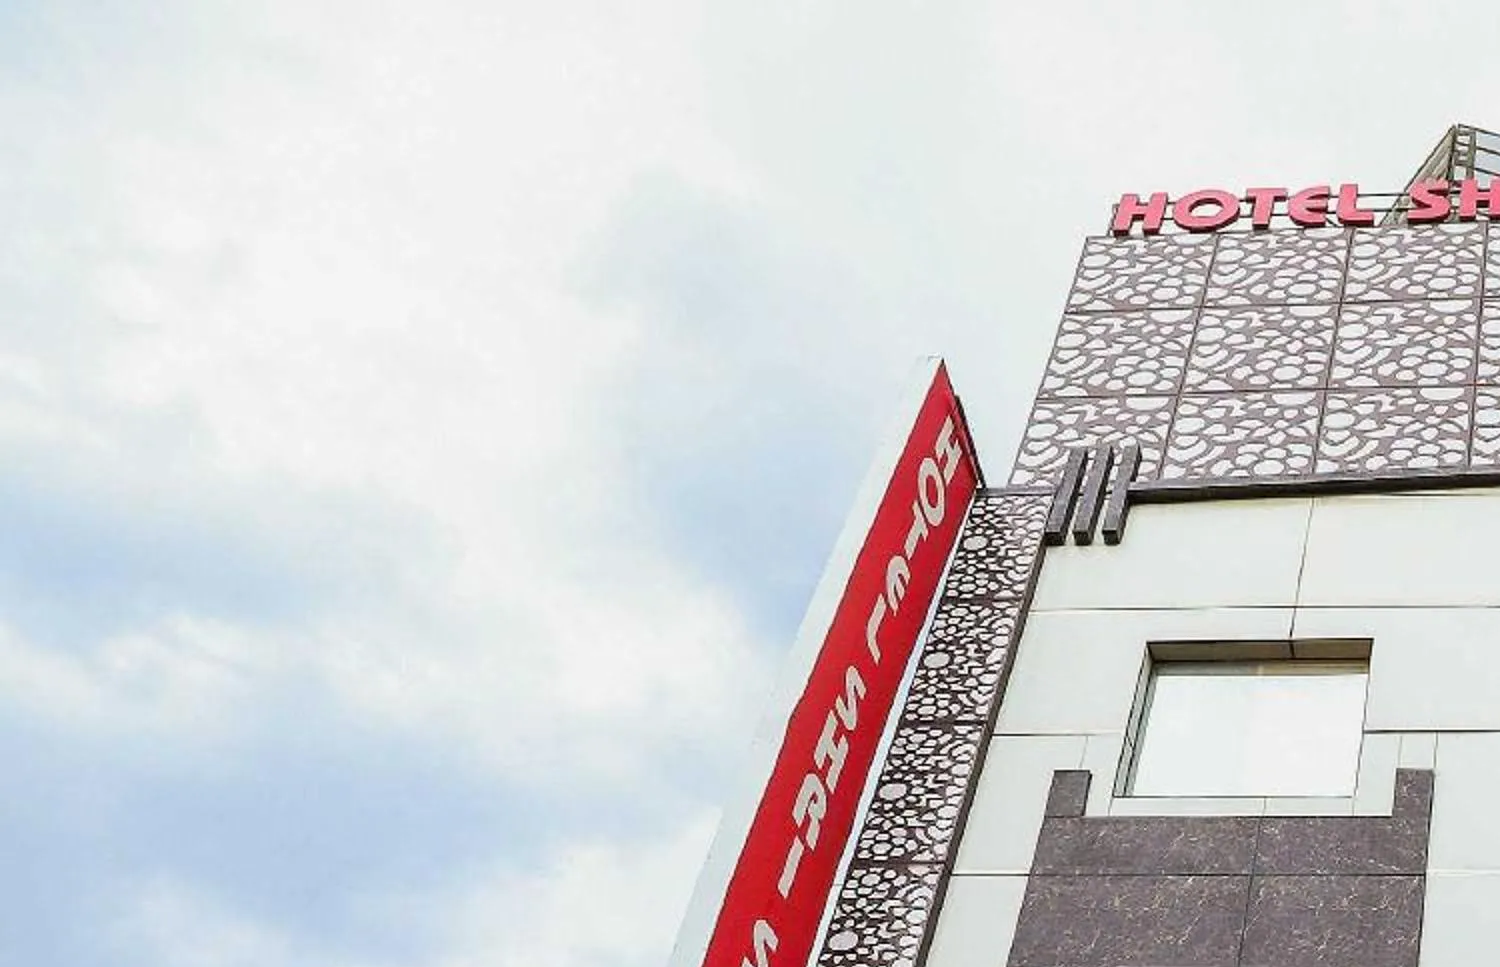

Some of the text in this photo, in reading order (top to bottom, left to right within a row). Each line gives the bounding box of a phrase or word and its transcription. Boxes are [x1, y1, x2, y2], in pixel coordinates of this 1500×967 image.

[1111, 183, 1375, 238] HOTEL
[864, 414, 963, 666] HOTEL
[777, 664, 867, 899] SHRI
